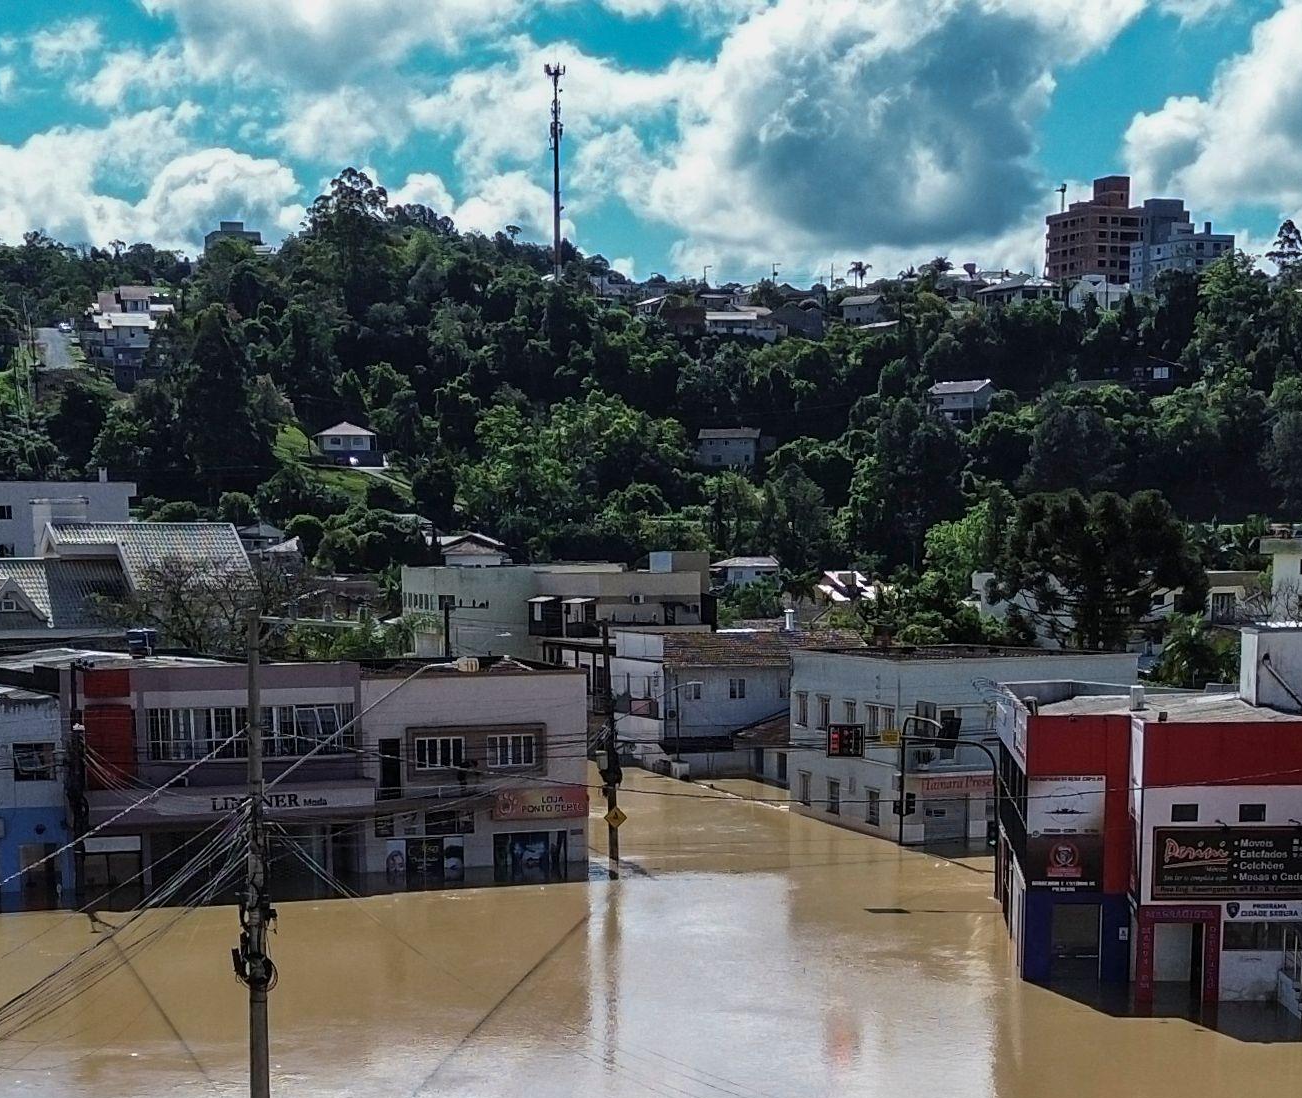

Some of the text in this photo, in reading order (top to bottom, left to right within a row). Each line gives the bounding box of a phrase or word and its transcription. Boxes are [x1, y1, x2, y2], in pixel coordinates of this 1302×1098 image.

[541, 795, 564, 804] LOJA
[521, 804, 553, 813] PONTO
[1165, 837, 1229, 862] Perini
